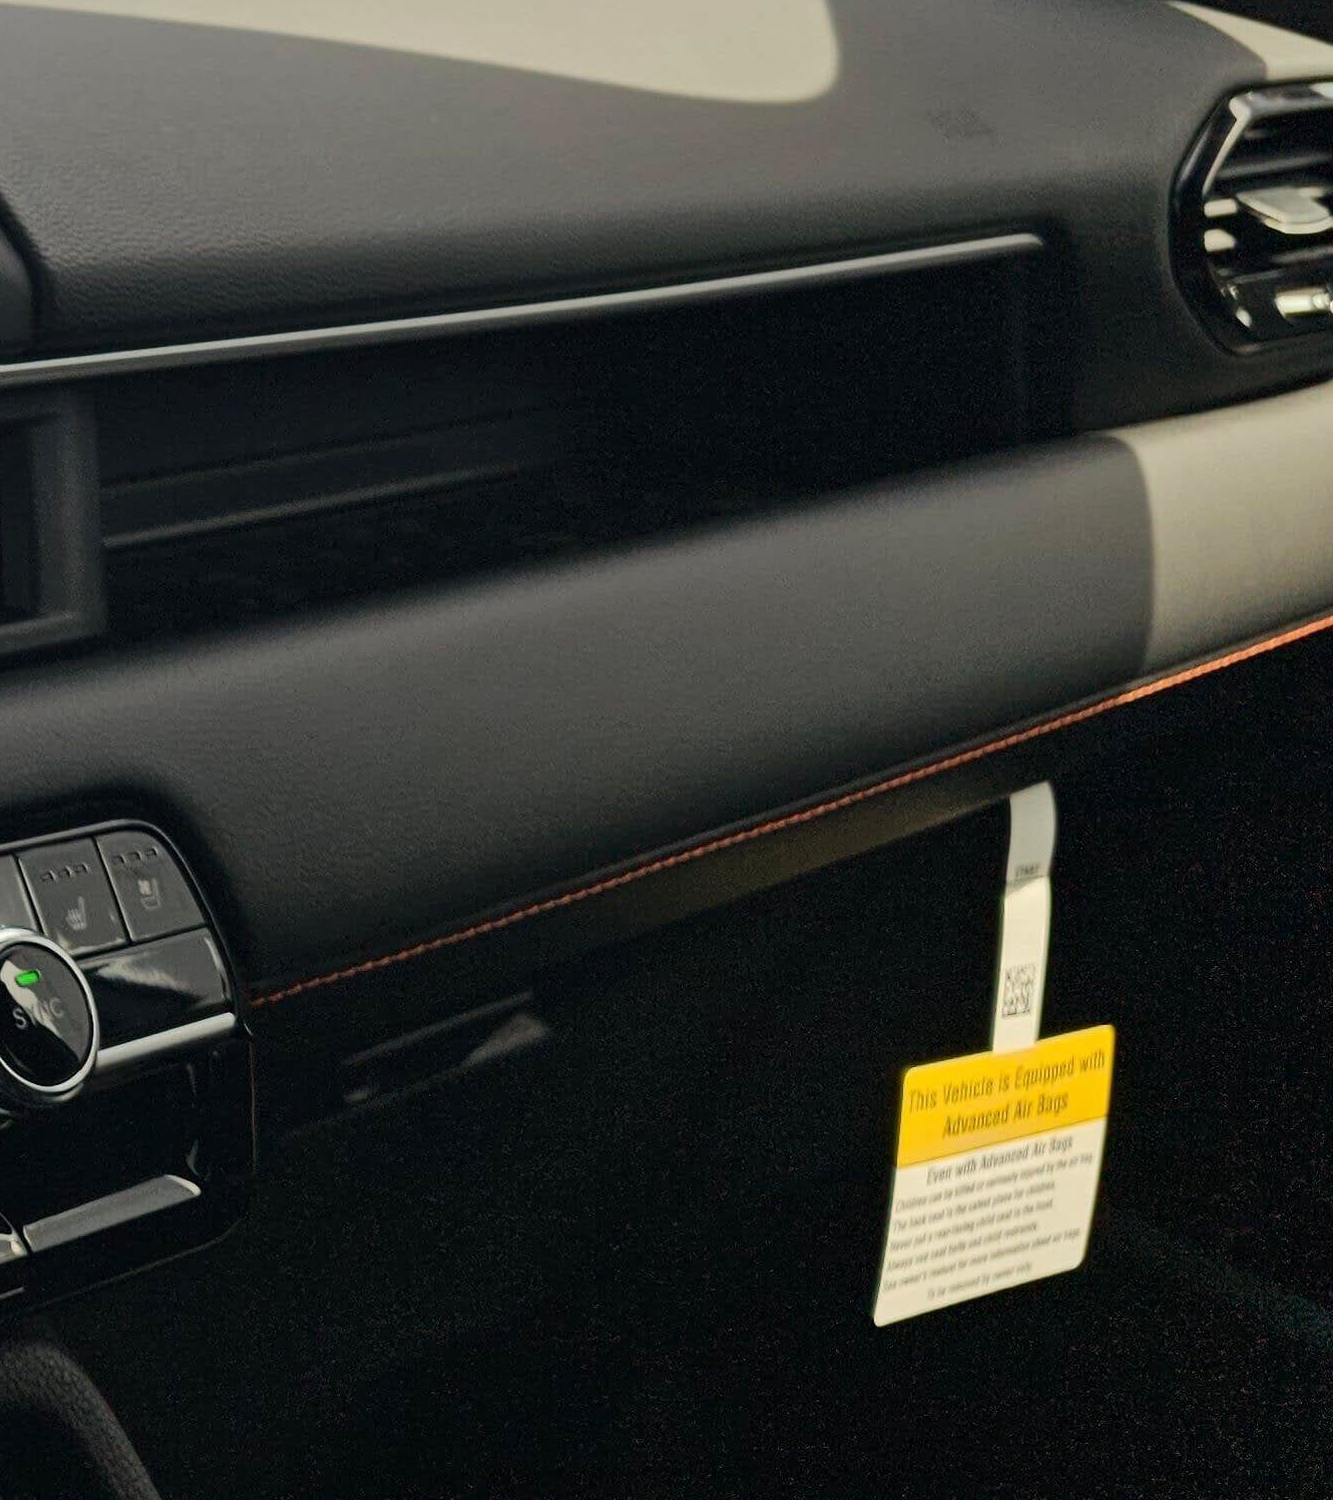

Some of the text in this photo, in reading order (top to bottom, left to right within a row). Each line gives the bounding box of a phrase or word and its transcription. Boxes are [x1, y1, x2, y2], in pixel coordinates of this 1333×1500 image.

[909, 1049, 1106, 1113] This Vehicle is Equipped with
[942, 1092, 1069, 1138] Advanced Air Bags
[927, 1162, 952, 1186] Even
[954, 1158, 977, 1177] with
[979, 1144, 1029, 1173] Advanced
